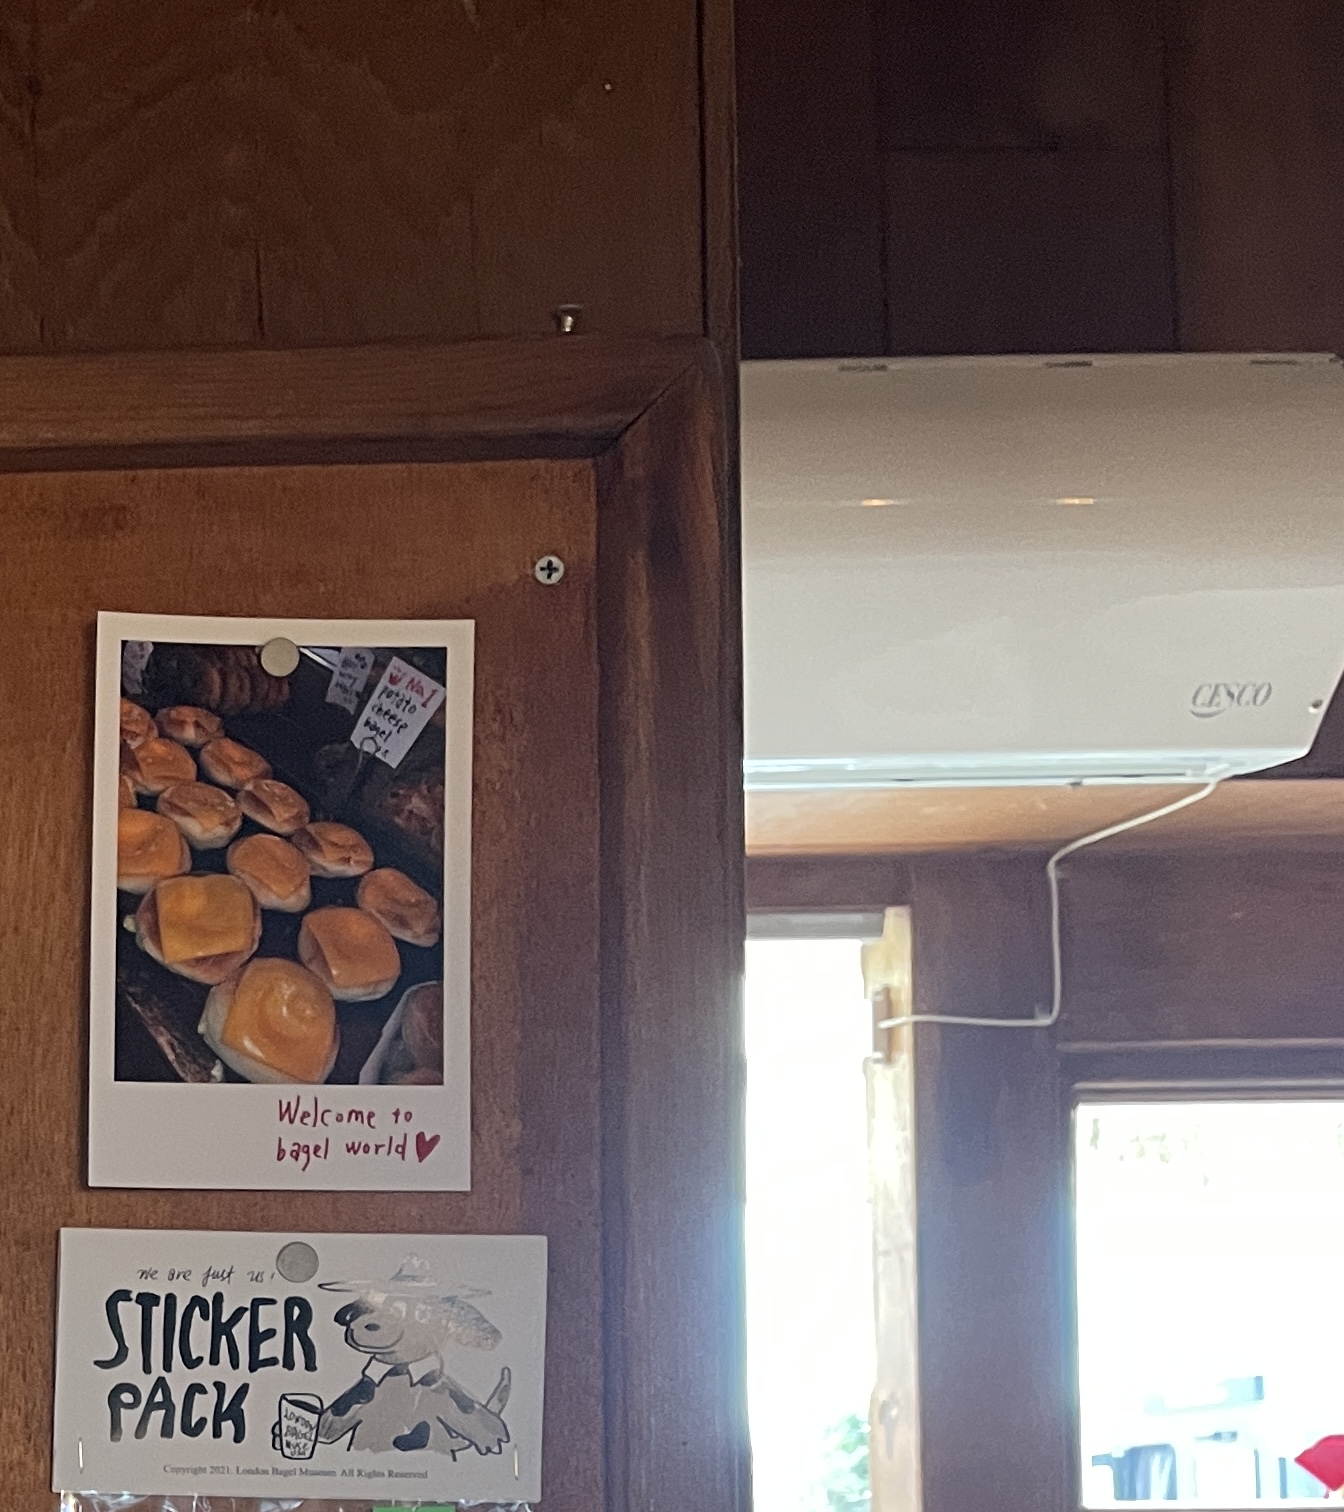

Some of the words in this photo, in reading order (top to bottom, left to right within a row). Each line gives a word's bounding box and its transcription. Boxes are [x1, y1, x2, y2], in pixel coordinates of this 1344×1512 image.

[1192, 683, 1272, 707] CESCO
[279, 1095, 375, 1129] Welcome
[392, 1108, 412, 1124] to
[277, 1137, 329, 1171] bagel
[346, 1133, 407, 1161] world
[168, 1269, 191, 1281] are
[202, 1266, 234, 1287] just
[94, 1289, 317, 1375] STICKER
[108, 1376, 249, 1444] PACK
[163, 1465, 207, 1476] Copyright
[236, 1466, 269, 1475] London
[272, 1467, 296, 1477] Bagel
[299, 1468, 336, 1476] Museum
[341, 1469, 354, 1477] All
[357, 1469, 385, 1479] Rights
[388, 1470, 428, 1479] Reserved
